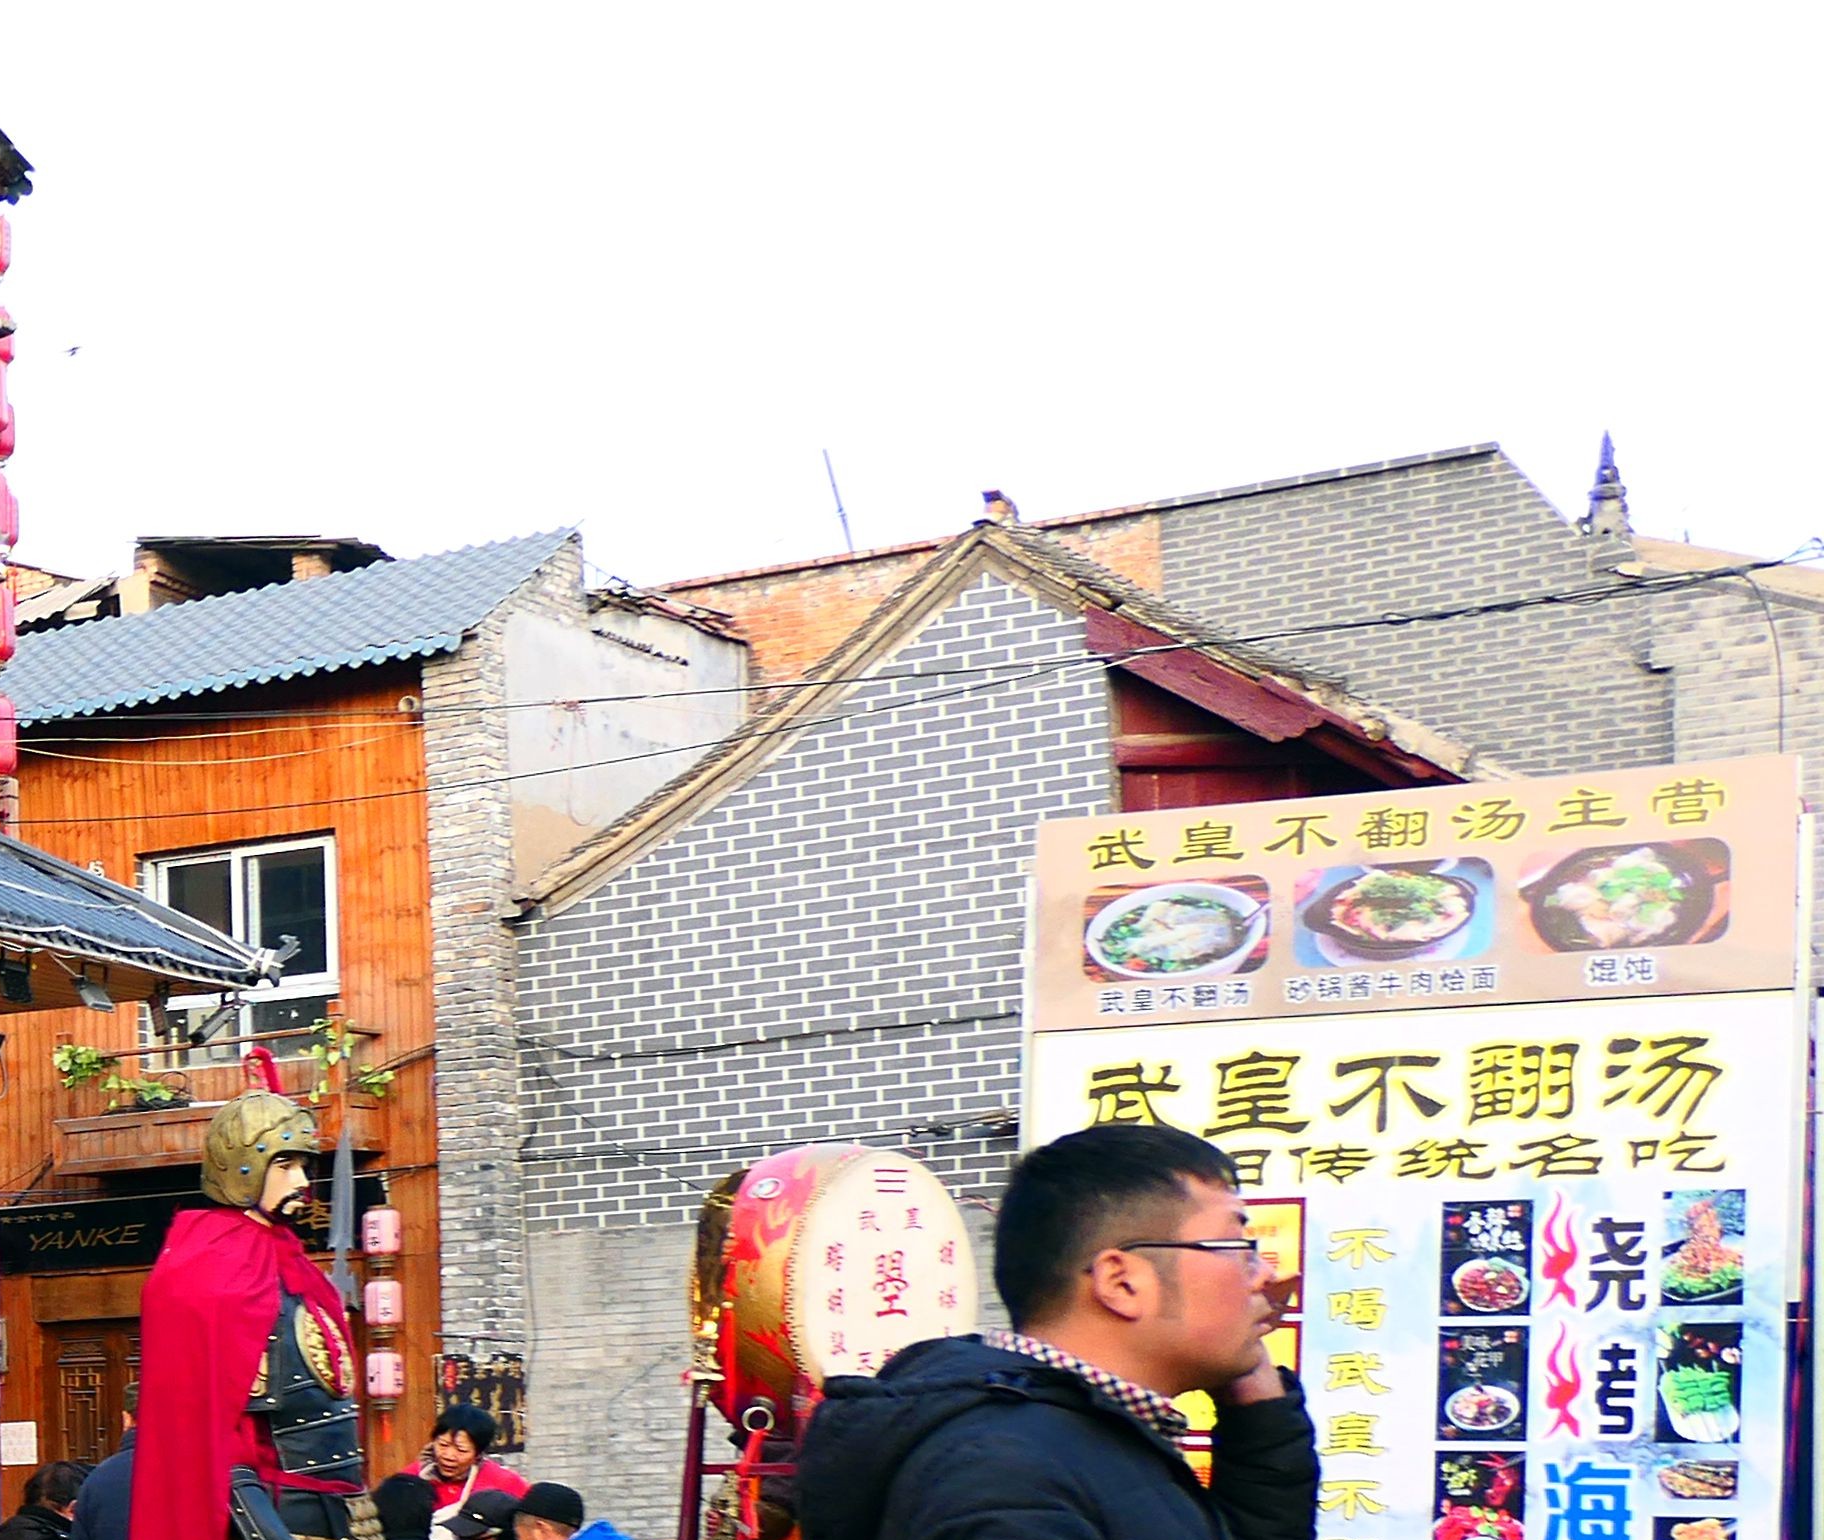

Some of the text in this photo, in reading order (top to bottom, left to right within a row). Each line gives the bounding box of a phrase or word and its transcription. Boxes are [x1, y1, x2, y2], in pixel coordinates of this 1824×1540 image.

[1086, 778, 1729, 872] 武皇不翻汤主营
[1284, 964, 1498, 1004] 砂锅酱牛肉烩面
[1586, 955, 1656, 985] 馄饨
[1097, 979, 1253, 1015] 武皇不翻汤
[1086, 1034, 1726, 1140] 武皇不翻汤
[29, 1223, 147, 1251] YANKE
